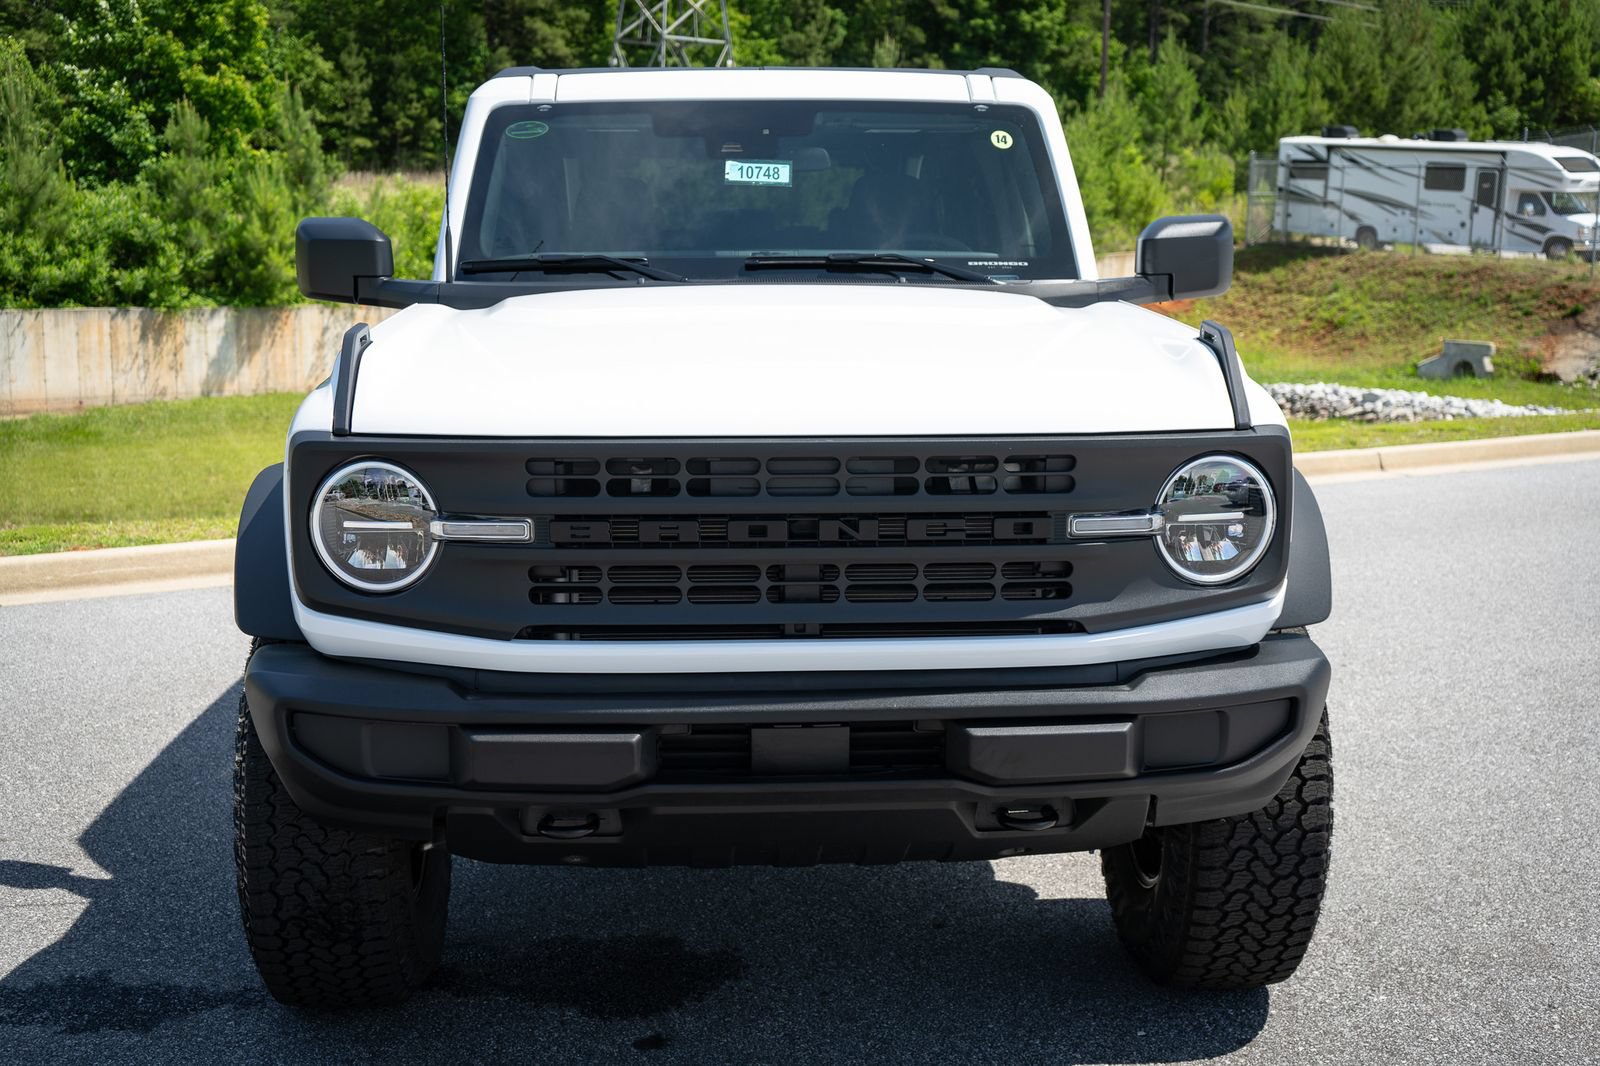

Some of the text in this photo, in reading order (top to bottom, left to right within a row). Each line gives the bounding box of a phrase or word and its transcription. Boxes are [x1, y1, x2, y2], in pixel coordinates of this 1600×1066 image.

[996, 134, 1008, 145] 14
[737, 165, 780, 180] 10748
[549, 518, 1049, 543] BRONCO
